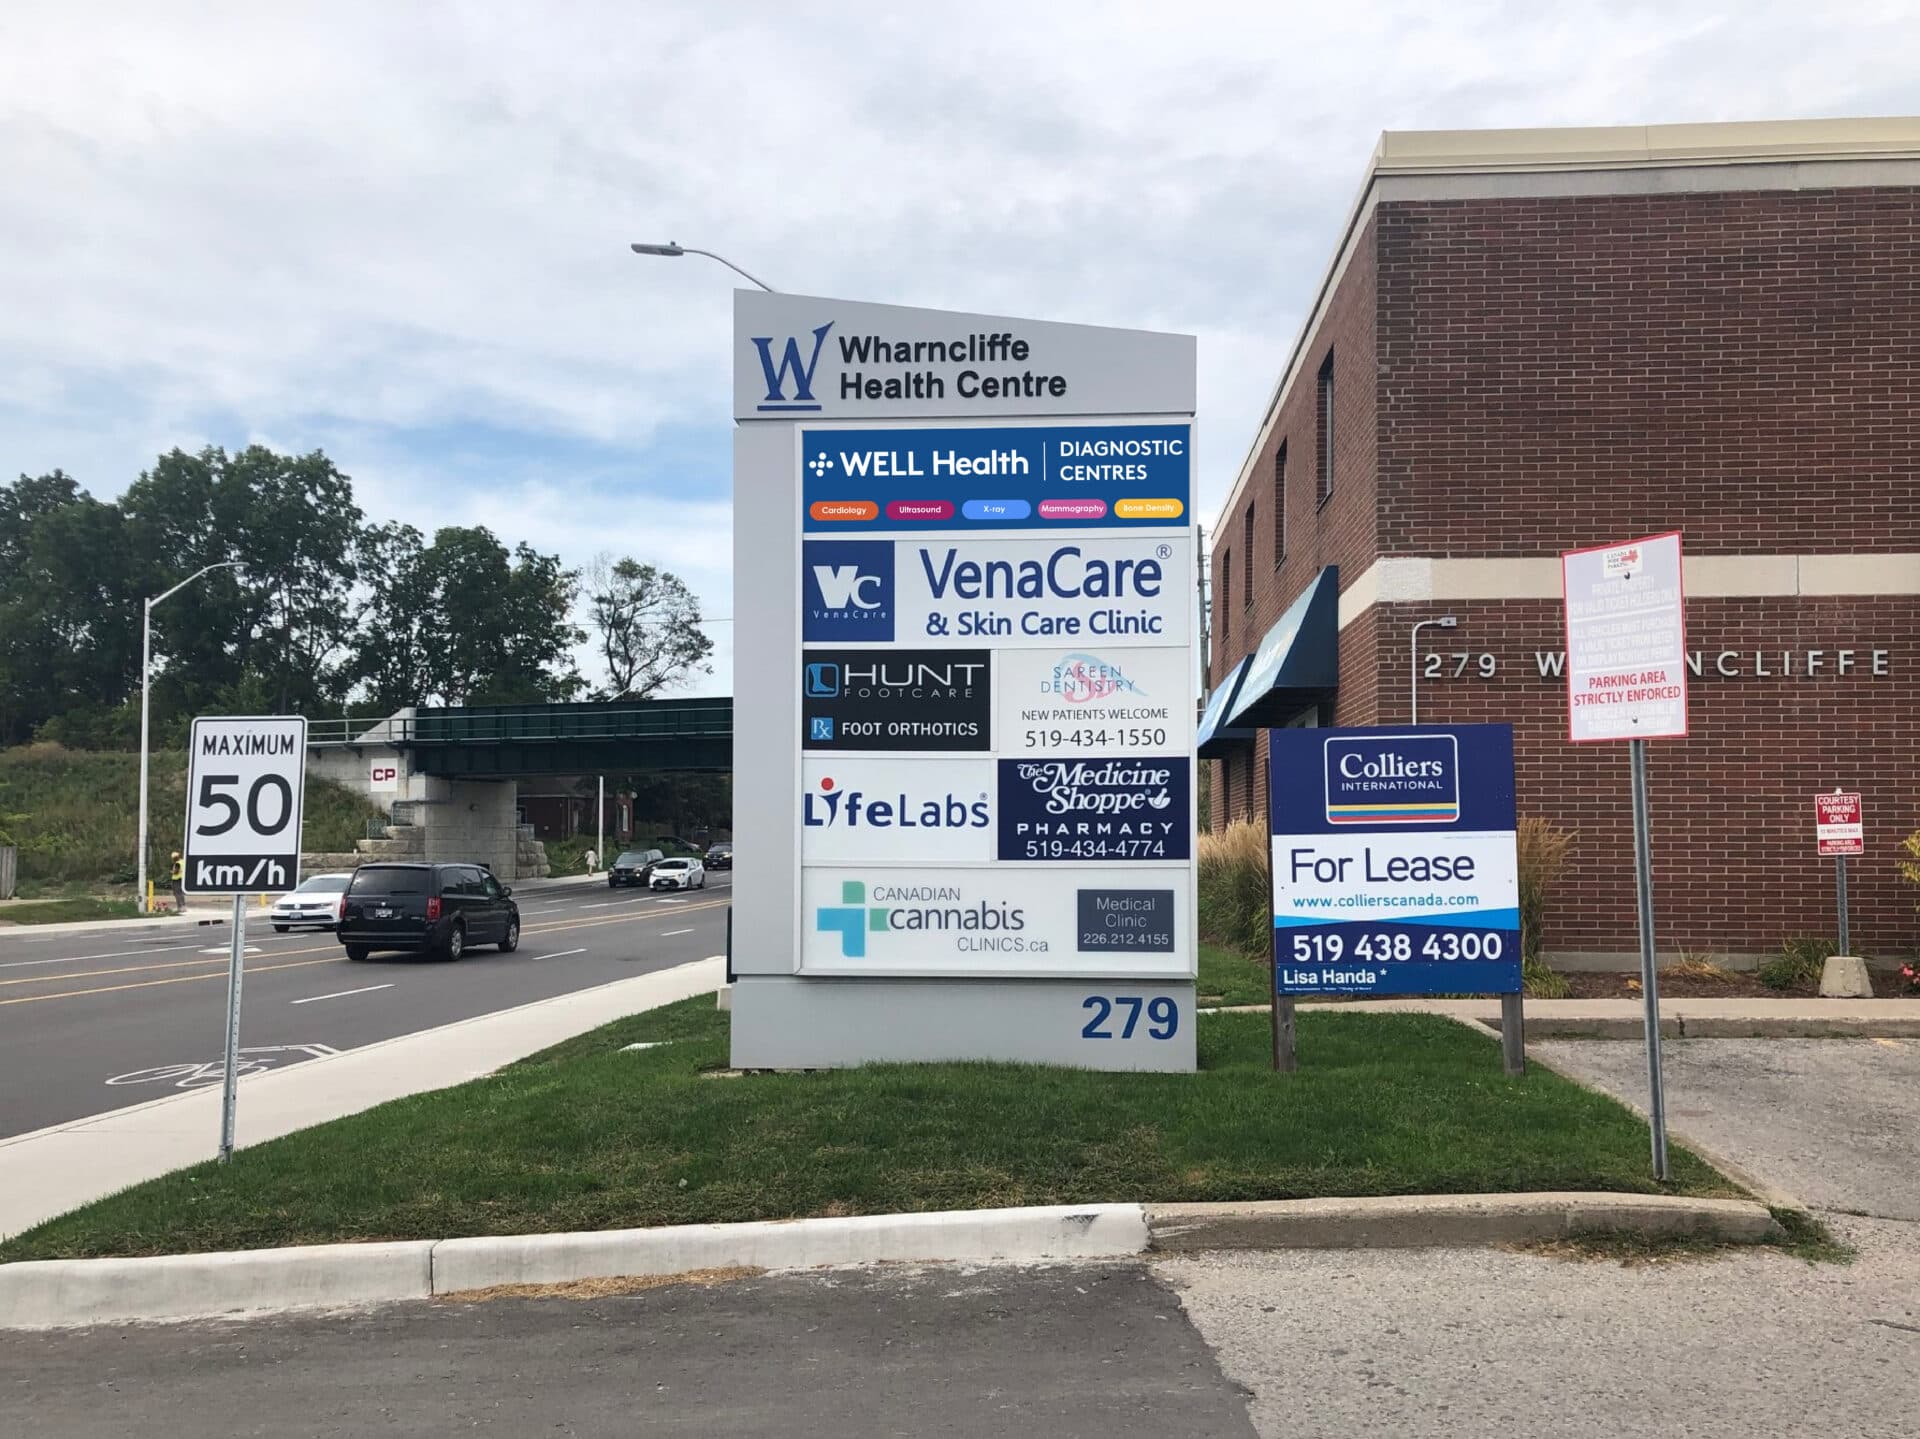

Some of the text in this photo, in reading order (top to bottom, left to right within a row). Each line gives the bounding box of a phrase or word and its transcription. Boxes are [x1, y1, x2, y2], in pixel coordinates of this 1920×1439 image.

[839, 334, 1030, 363] Wharncliffe
[840, 371, 1067, 400] Health Centre
[1060, 439, 1183, 457] DIAGNOSTIC
[840, 450, 1029, 476] WELL Health
[1060, 465, 1147, 481] CENTRES
[822, 505, 867, 517] Cardiology
[899, 505, 941, 514] Ultrasound
[983, 505, 1006, 515] X-ray
[1041, 504, 1104, 515] Mammography
[1123, 504, 1175, 515] Bone Density
[813, 610, 887, 619] VenaCare
[926, 610, 1162, 636] & Skin Care Clinic
[1424, 653, 1496, 678] 279
[1535, 650, 1889, 677] WNCLIFFE
[845, 664, 984, 686] HUNT
[1053, 666, 1122, 679] SAREEN
[1589, 671, 1666, 688] PARKING AREA
[845, 688, 972, 698] FOOTCARE
[1041, 680, 1136, 693] DENTISTRY
[1574, 686, 1681, 706] STRICTLY ENFORCED
[1022, 708, 1168, 721] NEW PATIENTS WELCOME
[842, 722, 882, 736] FOOT
[888, 722, 978, 736] ORTHOTICS
[202, 734, 295, 756] MAXIMUM
[1026, 728, 1166, 748] 519-434-1550
[1340, 752, 1443, 779] Colliers
[373, 769, 396, 781] CP
[1017, 761, 1170, 793] The Medicine
[1341, 780, 1443, 791] INTERNATIONAL
[195, 774, 293, 836] 50
[1046, 786, 1146, 814] Shoppe
[1818, 796, 1858, 805] COURTESY
[1822, 805, 1855, 814] PARKING
[1829, 814, 1849, 823] ONLY
[1017, 823, 1173, 835] PHARMACY
[1026, 840, 1165, 857] 519-434-4774
[197, 858, 286, 886] km/h
[1290, 847, 1475, 883] For Lease
[873, 887, 961, 901] CANADIAN
[1293, 893, 1479, 908] www.collierscanada.com
[1096, 897, 1155, 911] Medical
[890, 900, 1024, 930] cannabis
[1105, 913, 1147, 928] Clinic
[957, 937, 1048, 952] CLINICS.ca
[1083, 933, 1169, 945] 226.212.4155
[1293, 932, 1502, 962] 519 438 4300
[1283, 968, 1377, 985] Lisa Handa
[1081, 995, 1178, 1040] 279
